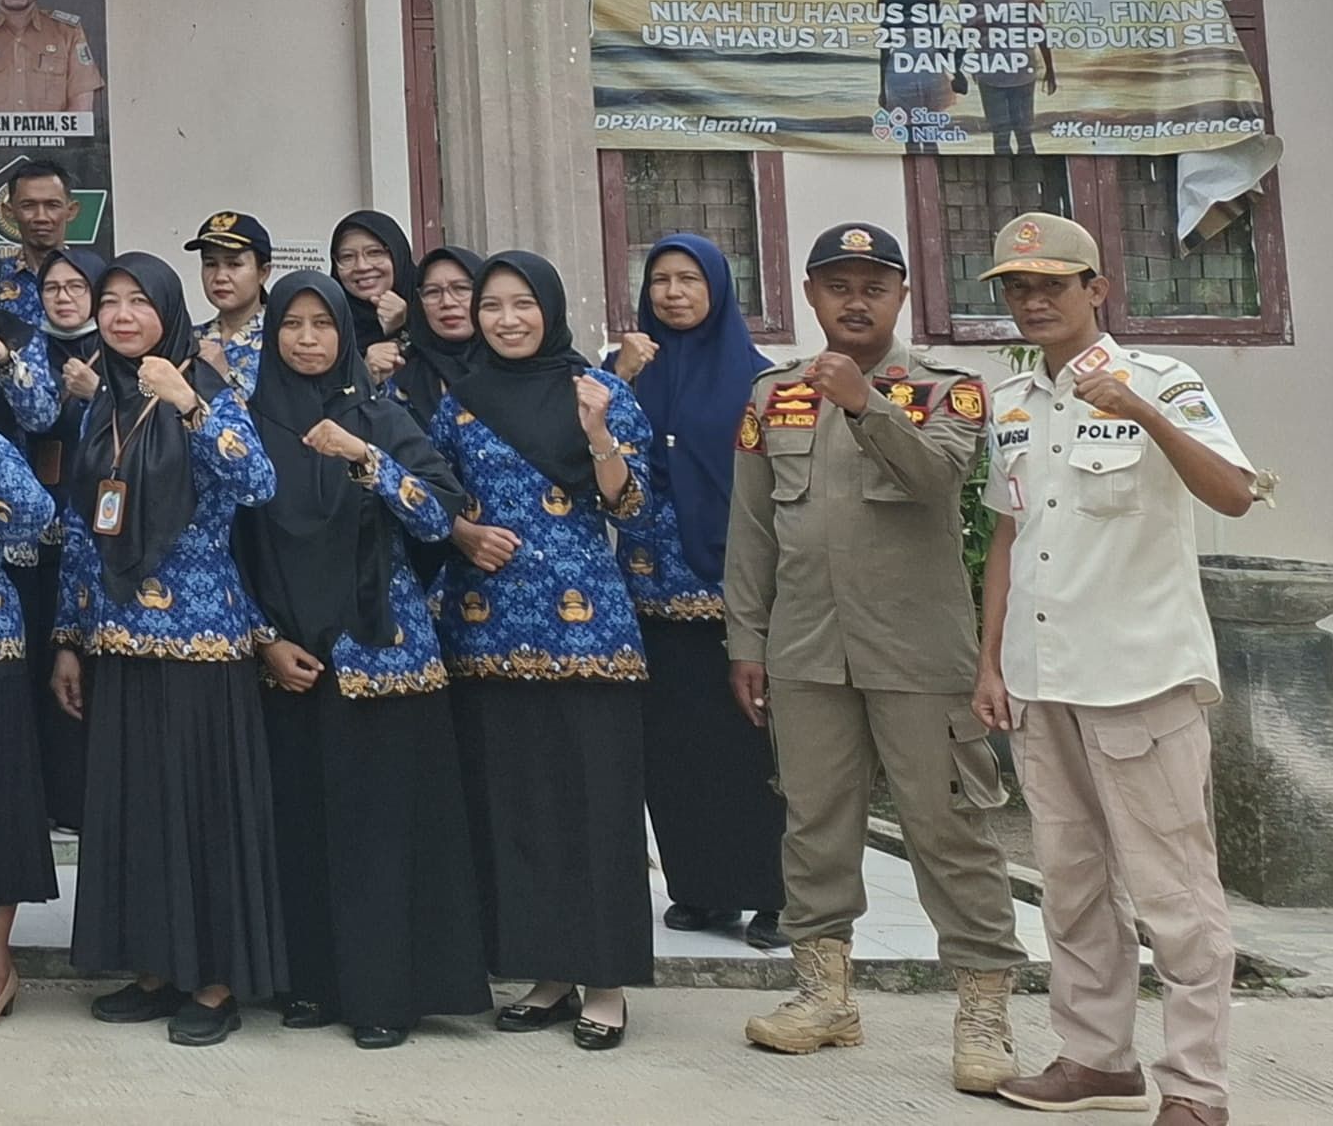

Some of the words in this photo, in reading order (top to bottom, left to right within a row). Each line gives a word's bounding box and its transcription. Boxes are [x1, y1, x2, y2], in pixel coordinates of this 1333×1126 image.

[649, 0, 742, 23] NIKAH
[750, 1, 796, 23] ITU
[804, 1, 904, 24] HARUS
[909, 2, 976, 24] SIAP
[985, 1, 1106, 26] MENTAL,
[1110, 0, 1225, 23] FINANS
[642, 25, 709, 48] USIA
[714, 26, 815, 49] HARUS
[823, 28, 850, 48] 21
[874, 27, 907, 49] 25
[913, 27, 982, 49] BIAR
[988, 26, 1176, 49] REPRODUKSI
[892, 52, 954, 74] DAN
[961, 52, 1034, 74] SIAP.
[13, 115, 59, 133] PATAH,
[61, 115, 78, 132] SE
[911, 108, 950, 126] Siap
[11, 137, 38, 147] PASIR
[39, 137, 65, 147] SAKTI
[912, 126, 967, 143] Nikah
